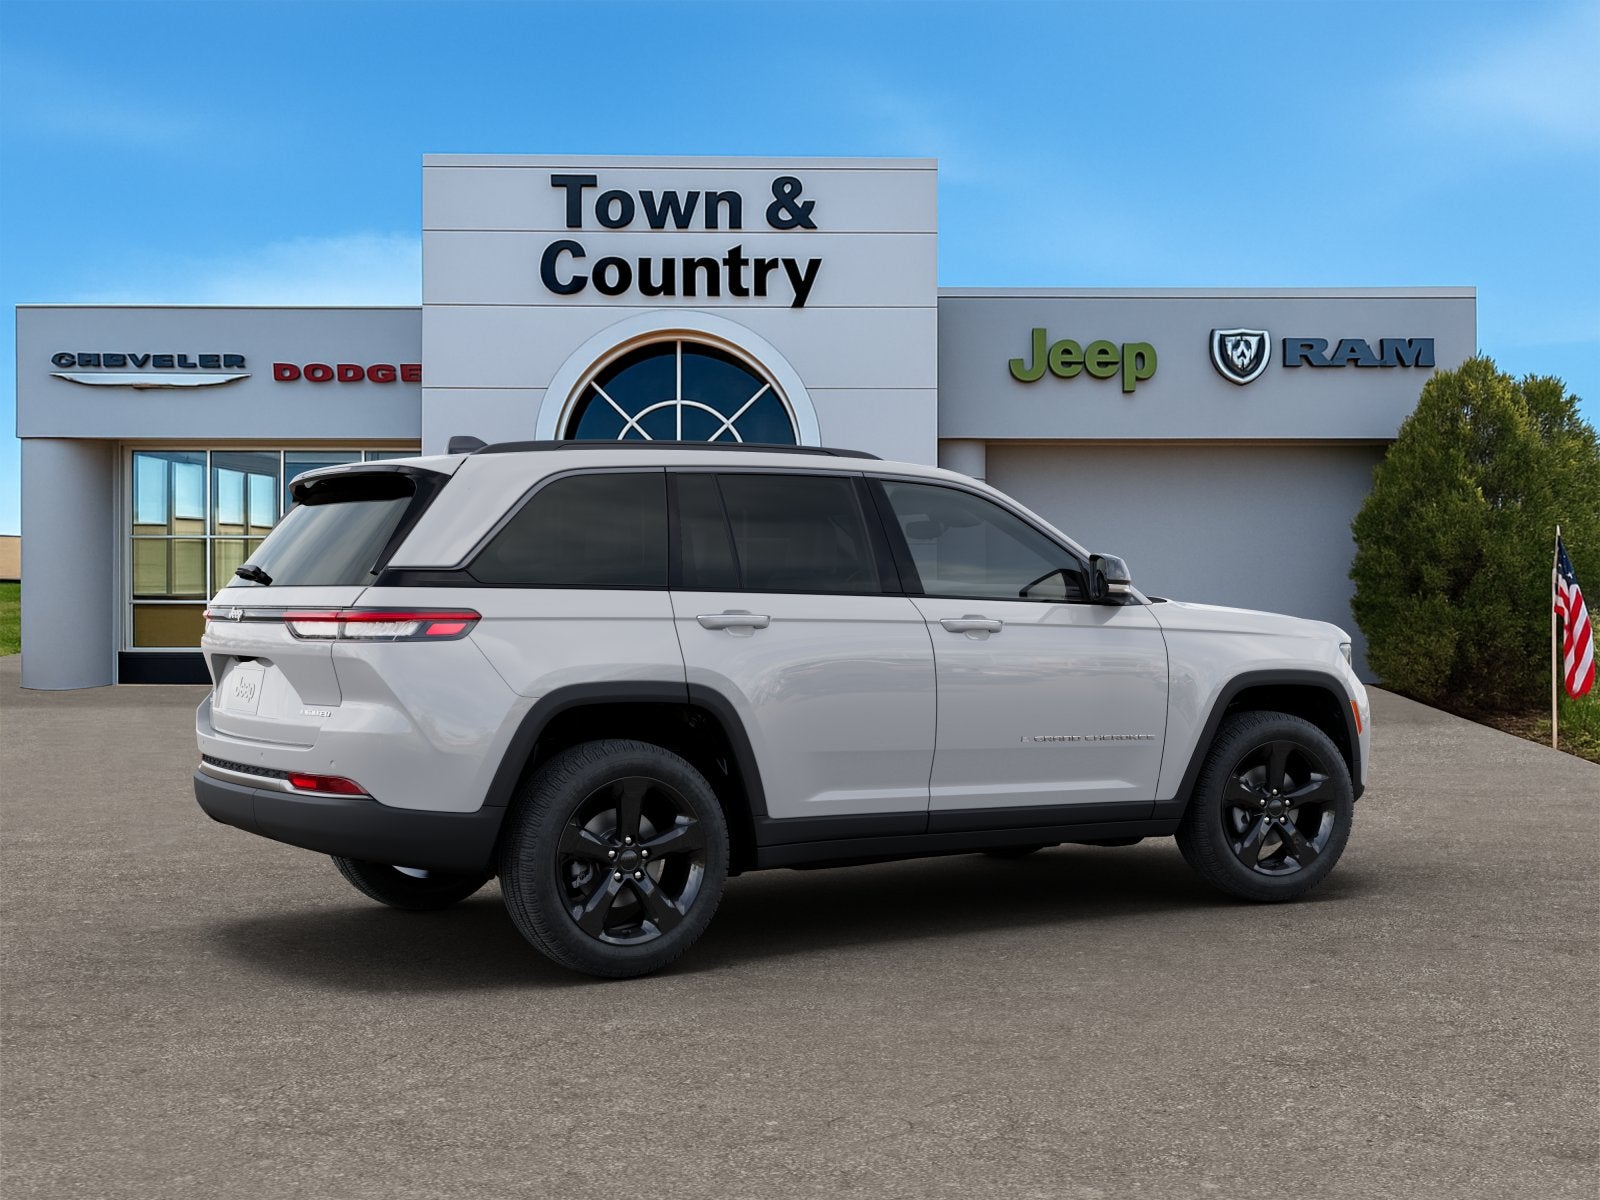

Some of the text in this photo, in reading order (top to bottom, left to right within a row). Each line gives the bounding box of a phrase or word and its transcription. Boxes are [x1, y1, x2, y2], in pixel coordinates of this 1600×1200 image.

[551, 174, 818, 230] Town &
[540, 239, 823, 309] Country
[272, 362, 422, 384] DODGE
[1009, 328, 1158, 394] Jeep
[1282, 337, 1436, 368] RAM
